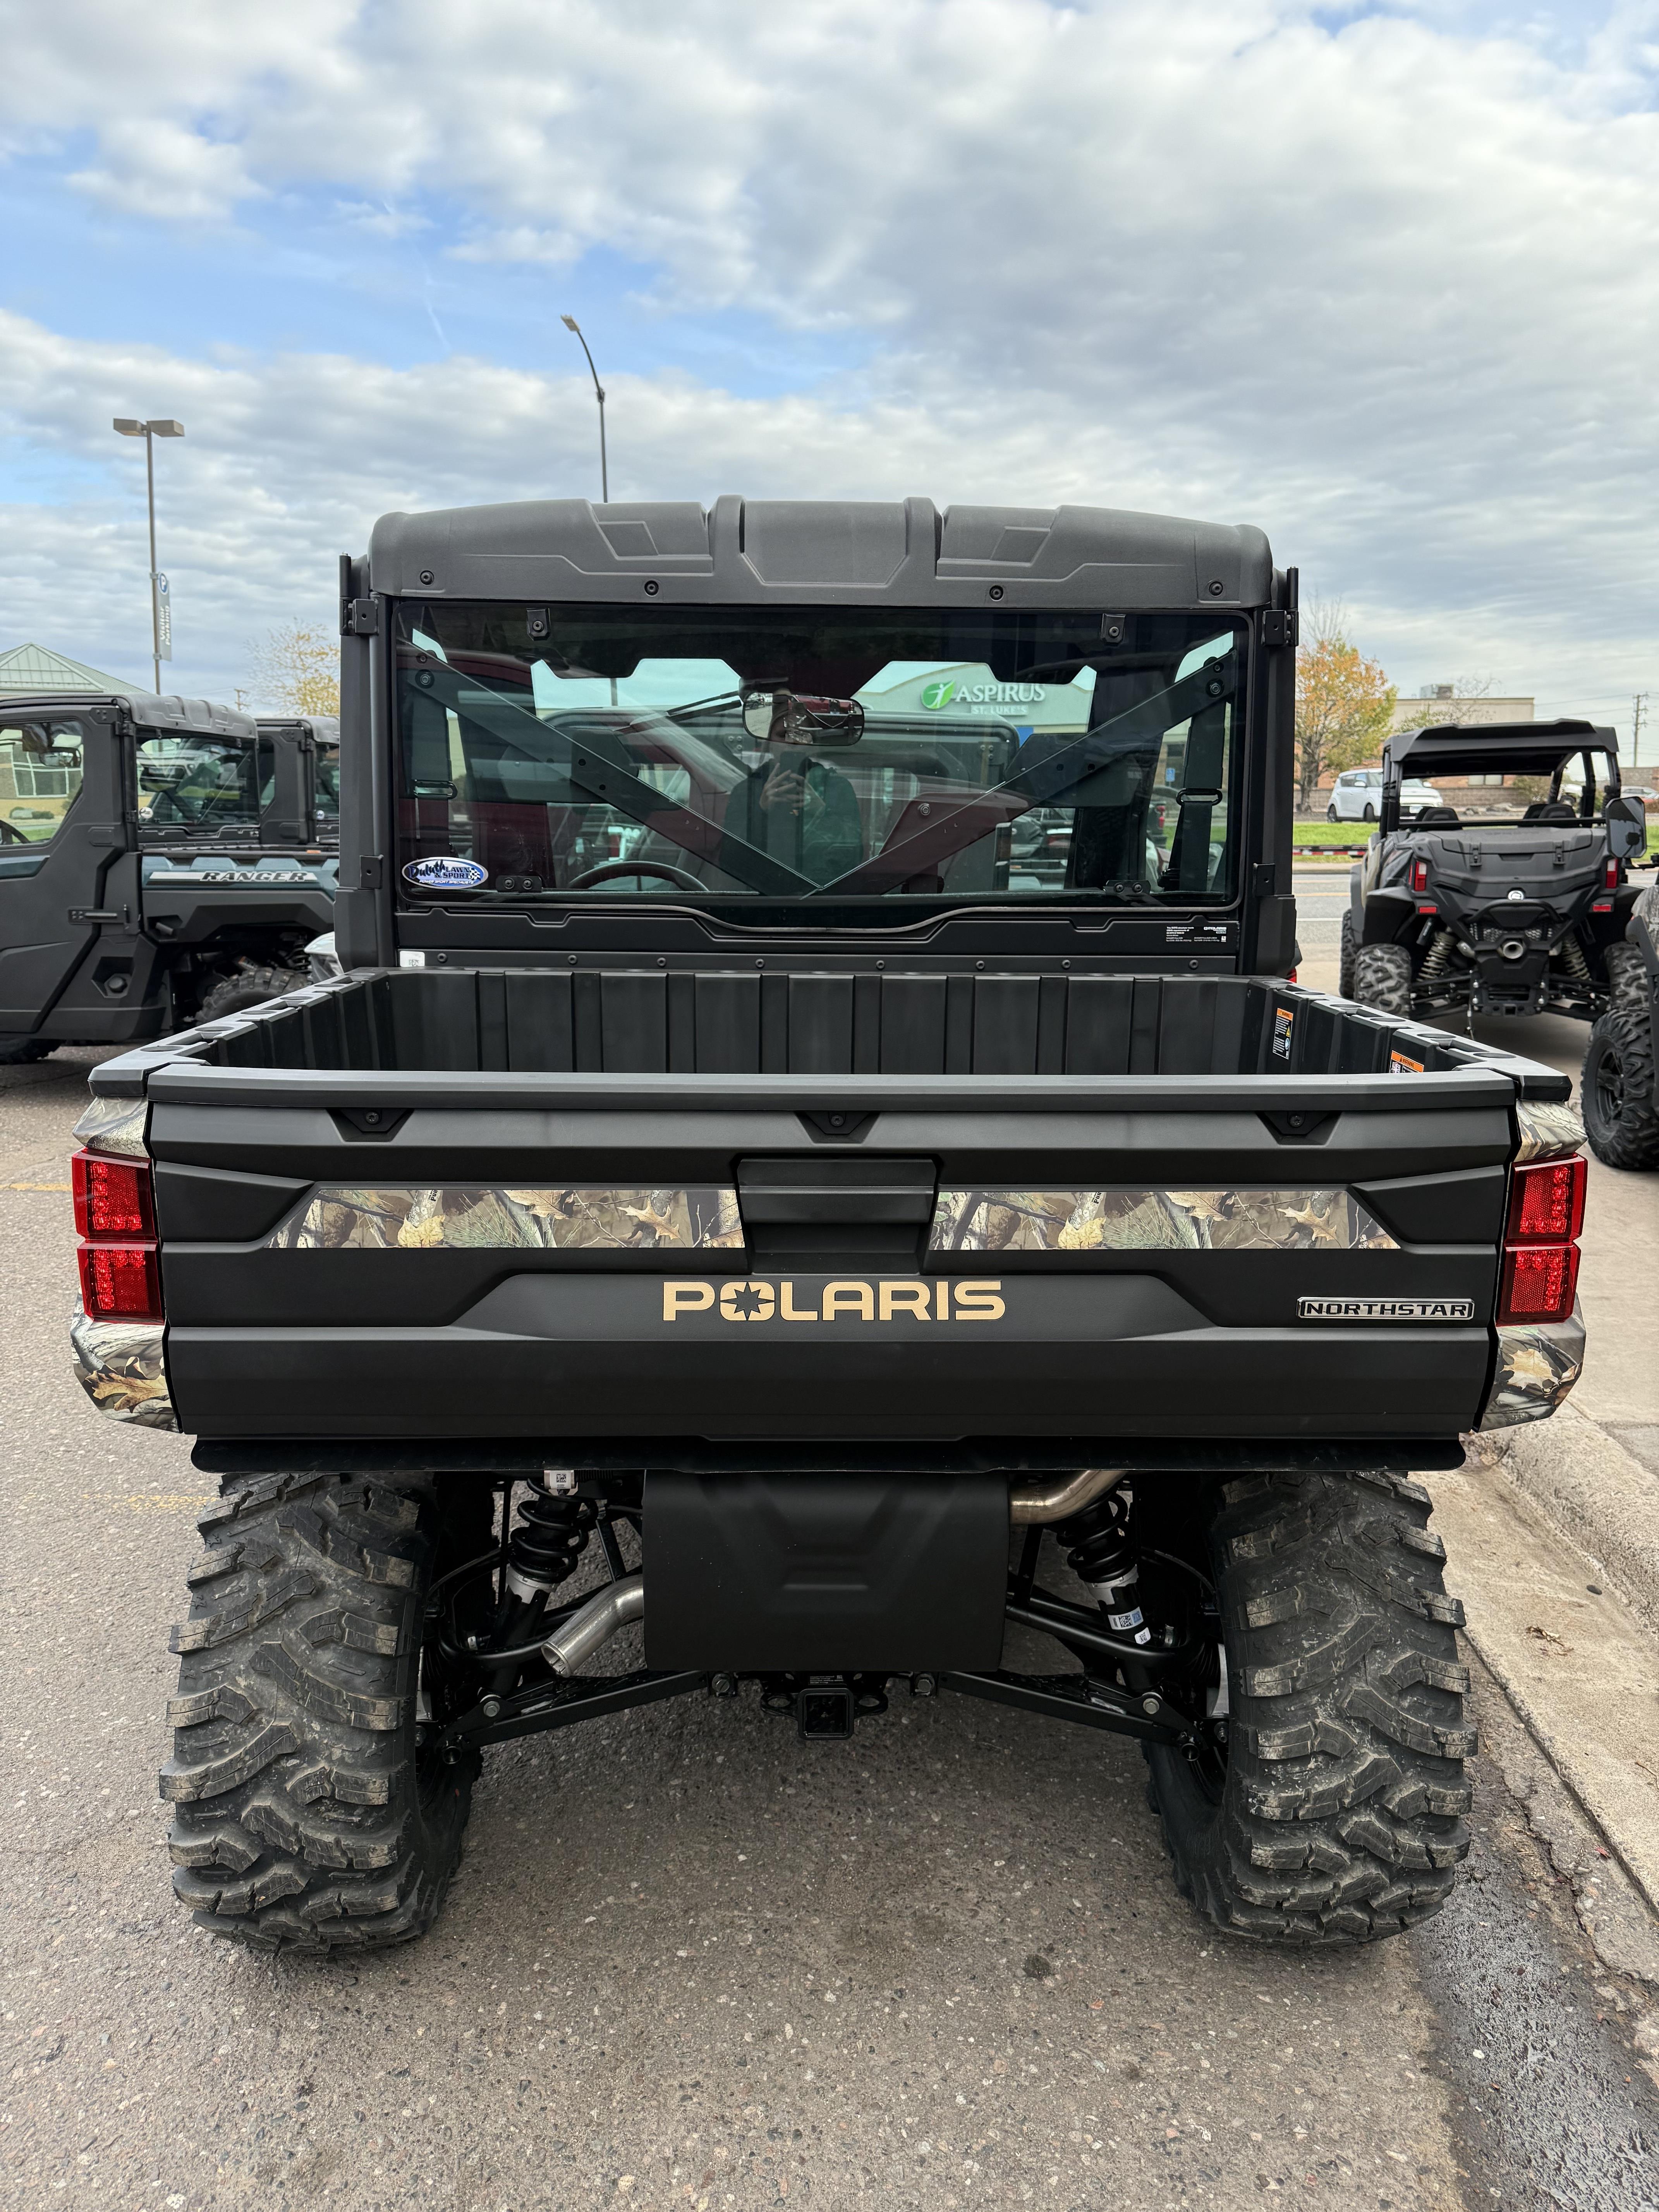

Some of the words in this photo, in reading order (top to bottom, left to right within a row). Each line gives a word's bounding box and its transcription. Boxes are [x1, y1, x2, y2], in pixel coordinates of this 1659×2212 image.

[955, 684, 1046, 702] ASPIRUS
[990, 706, 1027, 714] LUKE'S
[200, 871, 309, 882] RANGER
[407, 859, 446, 879] Duluth
[662, 1281, 1006, 1321] POLARIS
[1306, 1303, 1467, 1316] NORTHSTAR
